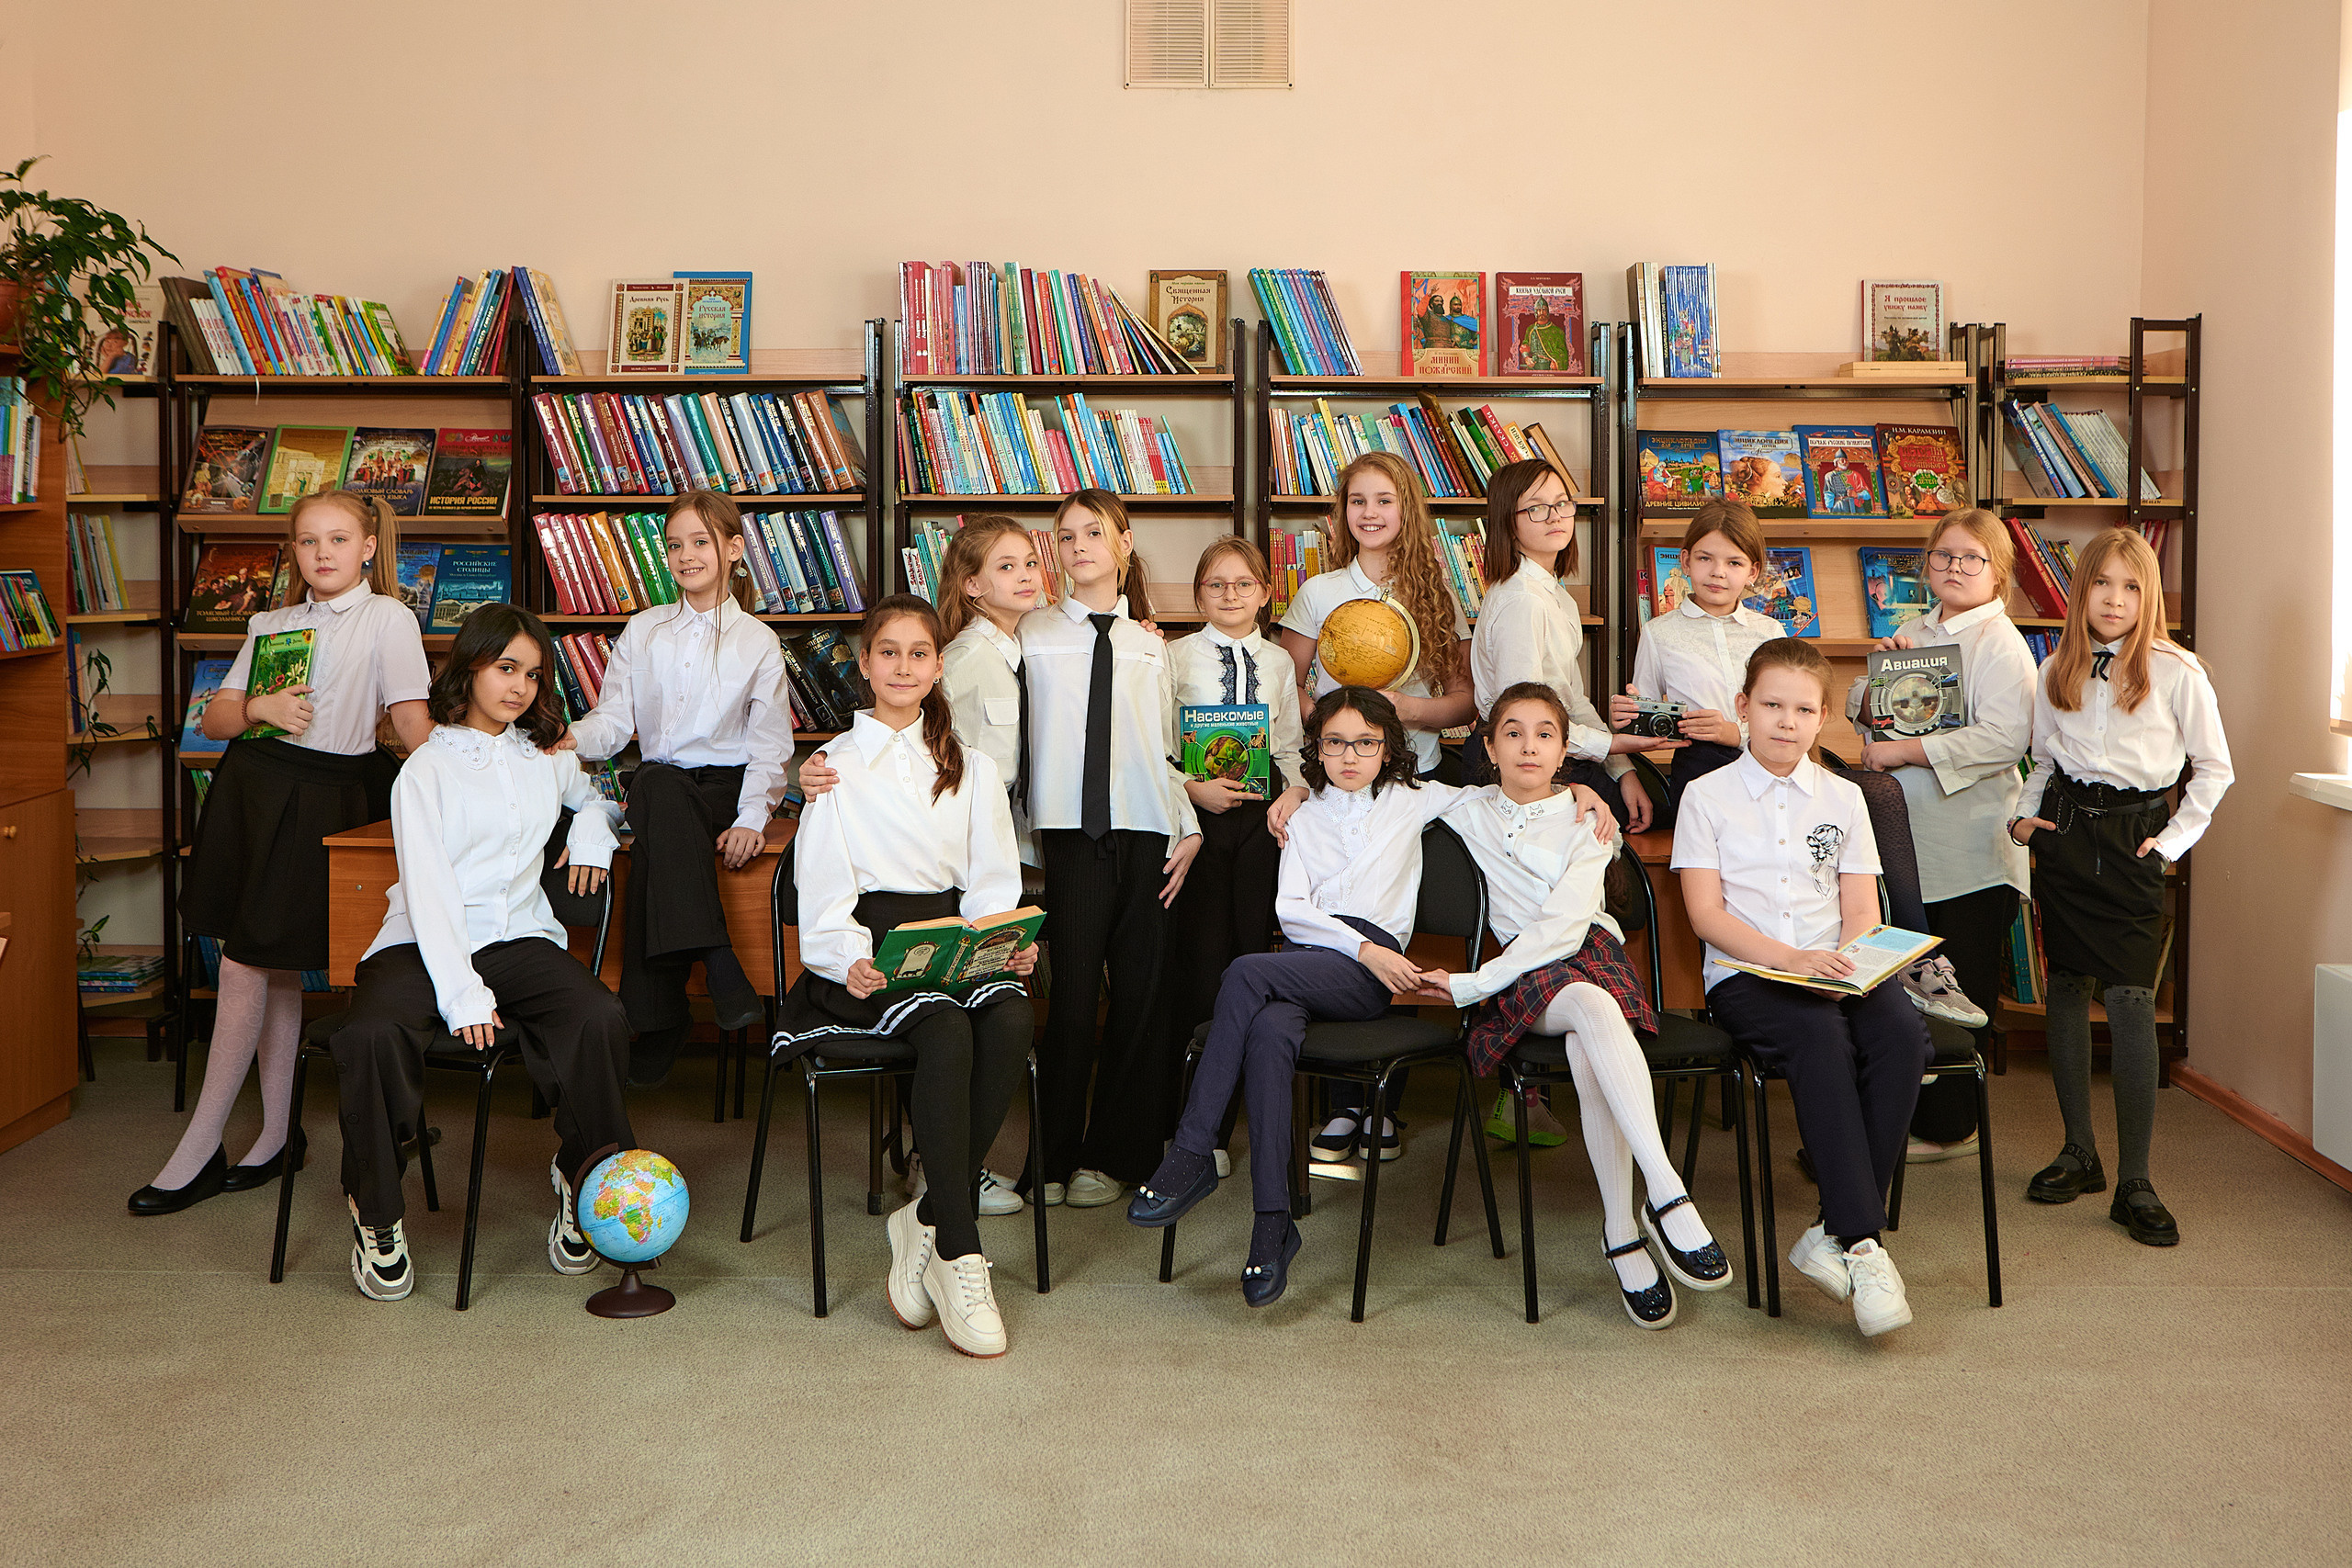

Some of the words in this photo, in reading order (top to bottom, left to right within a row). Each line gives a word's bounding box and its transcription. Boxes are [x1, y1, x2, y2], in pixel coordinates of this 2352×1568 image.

[1166, 286, 1211, 295] Священная
[1171, 296, 1204, 304] История
[1419, 365, 1472, 375] ПОЖАРСКИЙ
[1487, 412, 1509, 446] СКАЗКИ
[2040, 430, 2055, 454] РОССИИ
[2040, 452, 2054, 474] ИСТОРИЯ
[2054, 455, 2072, 480] ИСТОРИЯ
[430, 496, 465, 504] ИСТОРИЯ
[467, 496, 498, 504] РОССИИ
[1881, 656, 1948, 672] Авиация
[1184, 710, 1264, 722] Насекомые
